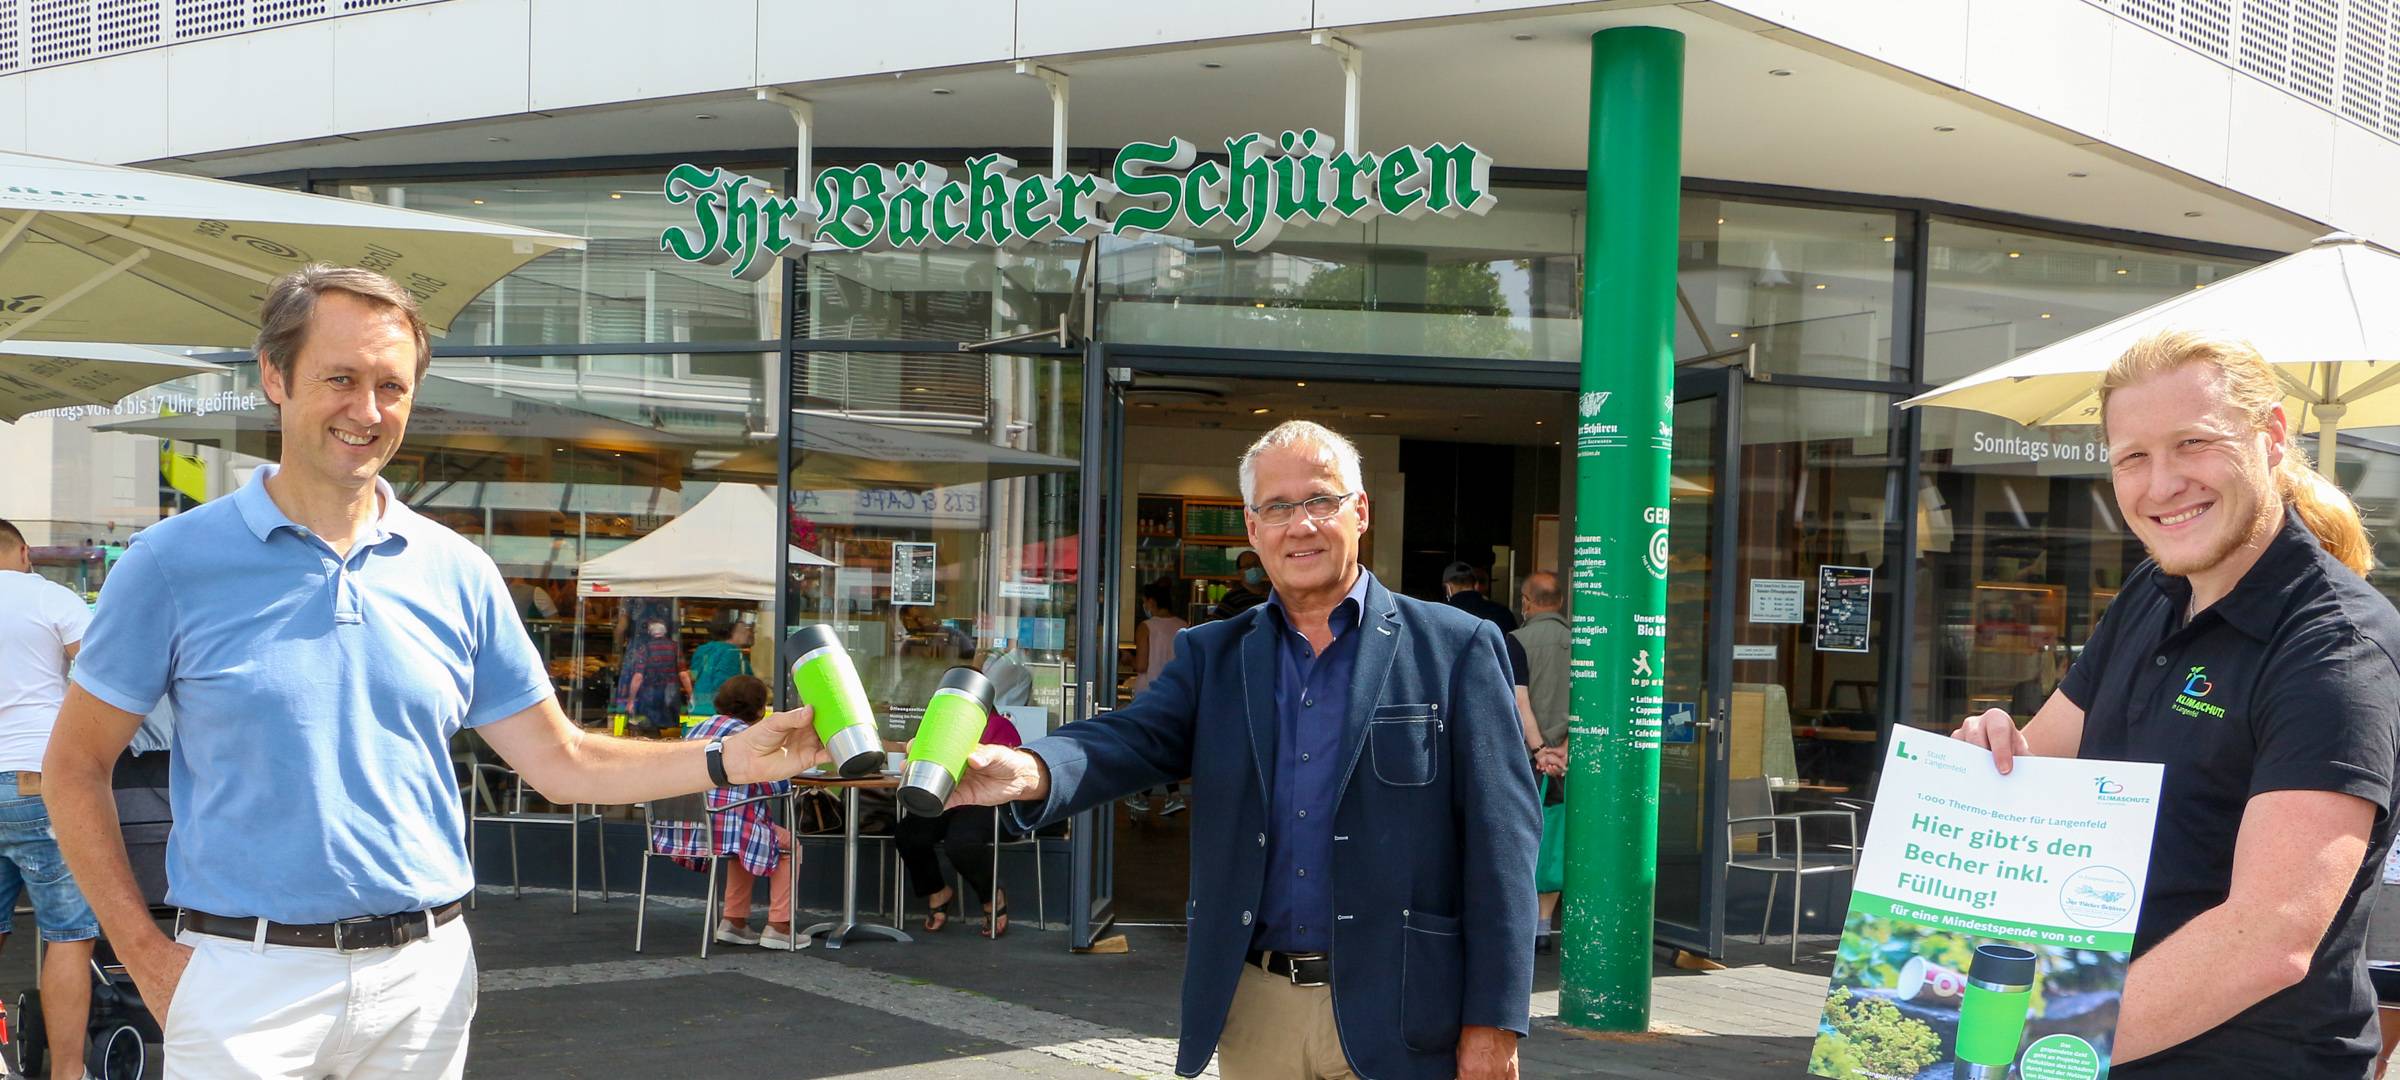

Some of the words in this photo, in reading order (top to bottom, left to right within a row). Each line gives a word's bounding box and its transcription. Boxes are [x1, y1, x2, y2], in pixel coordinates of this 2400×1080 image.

[660, 162, 800, 281] Ihr
[815, 153, 1098, 250] Bäcker
[1111, 127, 1482, 248] Schüren
[127, 397, 147, 415] bis
[150, 395, 164, 414] 17
[168, 395, 193, 413] Uhr
[196, 391, 256, 417] geöffnet
[1973, 432, 2049, 461] Sonntags
[2053, 443, 2080, 460] von
[2084, 443, 2095, 462] 8
[1582, 625, 1607, 635] möglich
[1634, 614, 1655, 623] Unser
[1637, 624, 1653, 636] Bio
[1631, 677, 1639, 686] to
[1641, 678, 1650, 687] go
[1924, 759, 1967, 774] Langenfeld
[1927, 751, 1946, 761] Stadt
[1917, 793, 1946, 806] 1.000
[1949, 799, 2027, 825] Thermo-Becher
[2030, 816, 2046, 826] für
[2048, 818, 2108, 830] Langenfeld
[2098, 795, 2150, 804] KLIMASCHUTZ
[1912, 813, 1964, 840] Hier
[2046, 838, 2093, 858] den
[1904, 842, 1989, 876] Becher
[1996, 860, 2049, 884] inkl.
[1897, 872, 1998, 910] Füllung!
[1889, 904, 1910, 916] für
[1911, 910, 1939, 924] eine
[1941, 915, 2038, 938] Mindestspende
[2041, 931, 2065, 942] von
[2068, 935, 2083, 944] 10
[2086, 934, 2096, 945] €
